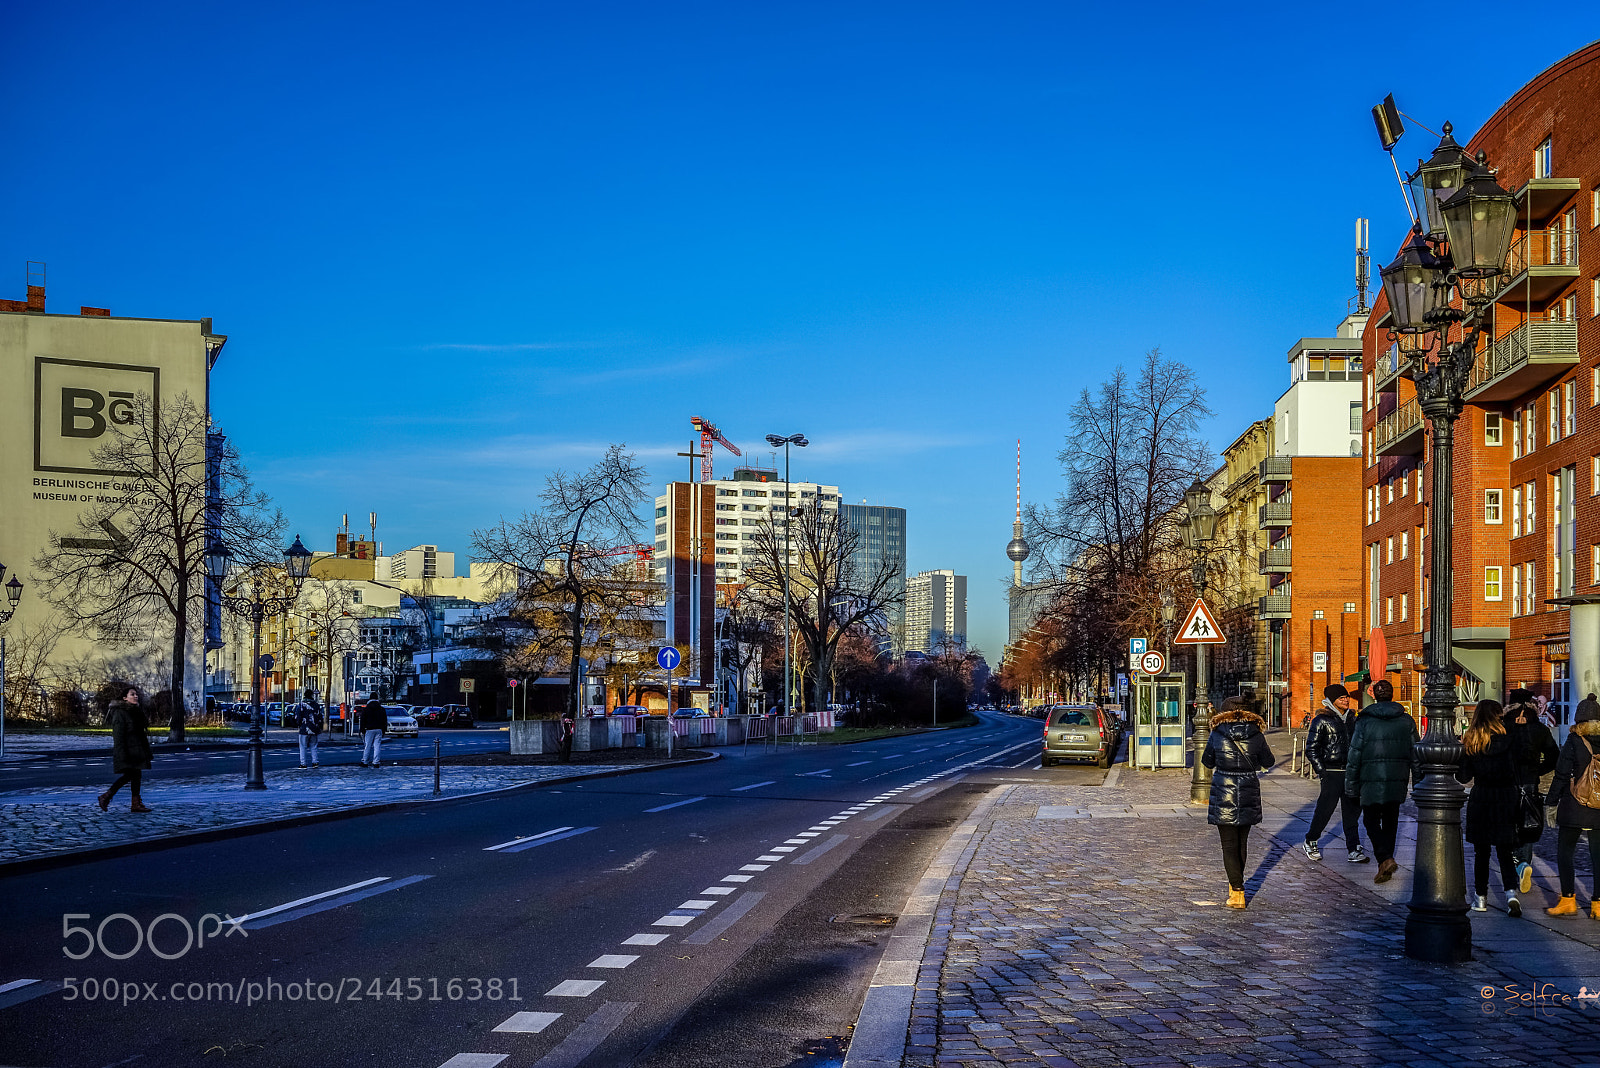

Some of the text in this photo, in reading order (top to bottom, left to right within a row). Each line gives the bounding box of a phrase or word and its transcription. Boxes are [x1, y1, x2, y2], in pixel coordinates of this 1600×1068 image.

[33, 477, 160, 493] BERLINISCHE GALERIE
[33, 492, 160, 506] MUSEUM OF MODERN ART
[1133, 640, 1143, 653] P
[1146, 657, 1160, 669] 50
